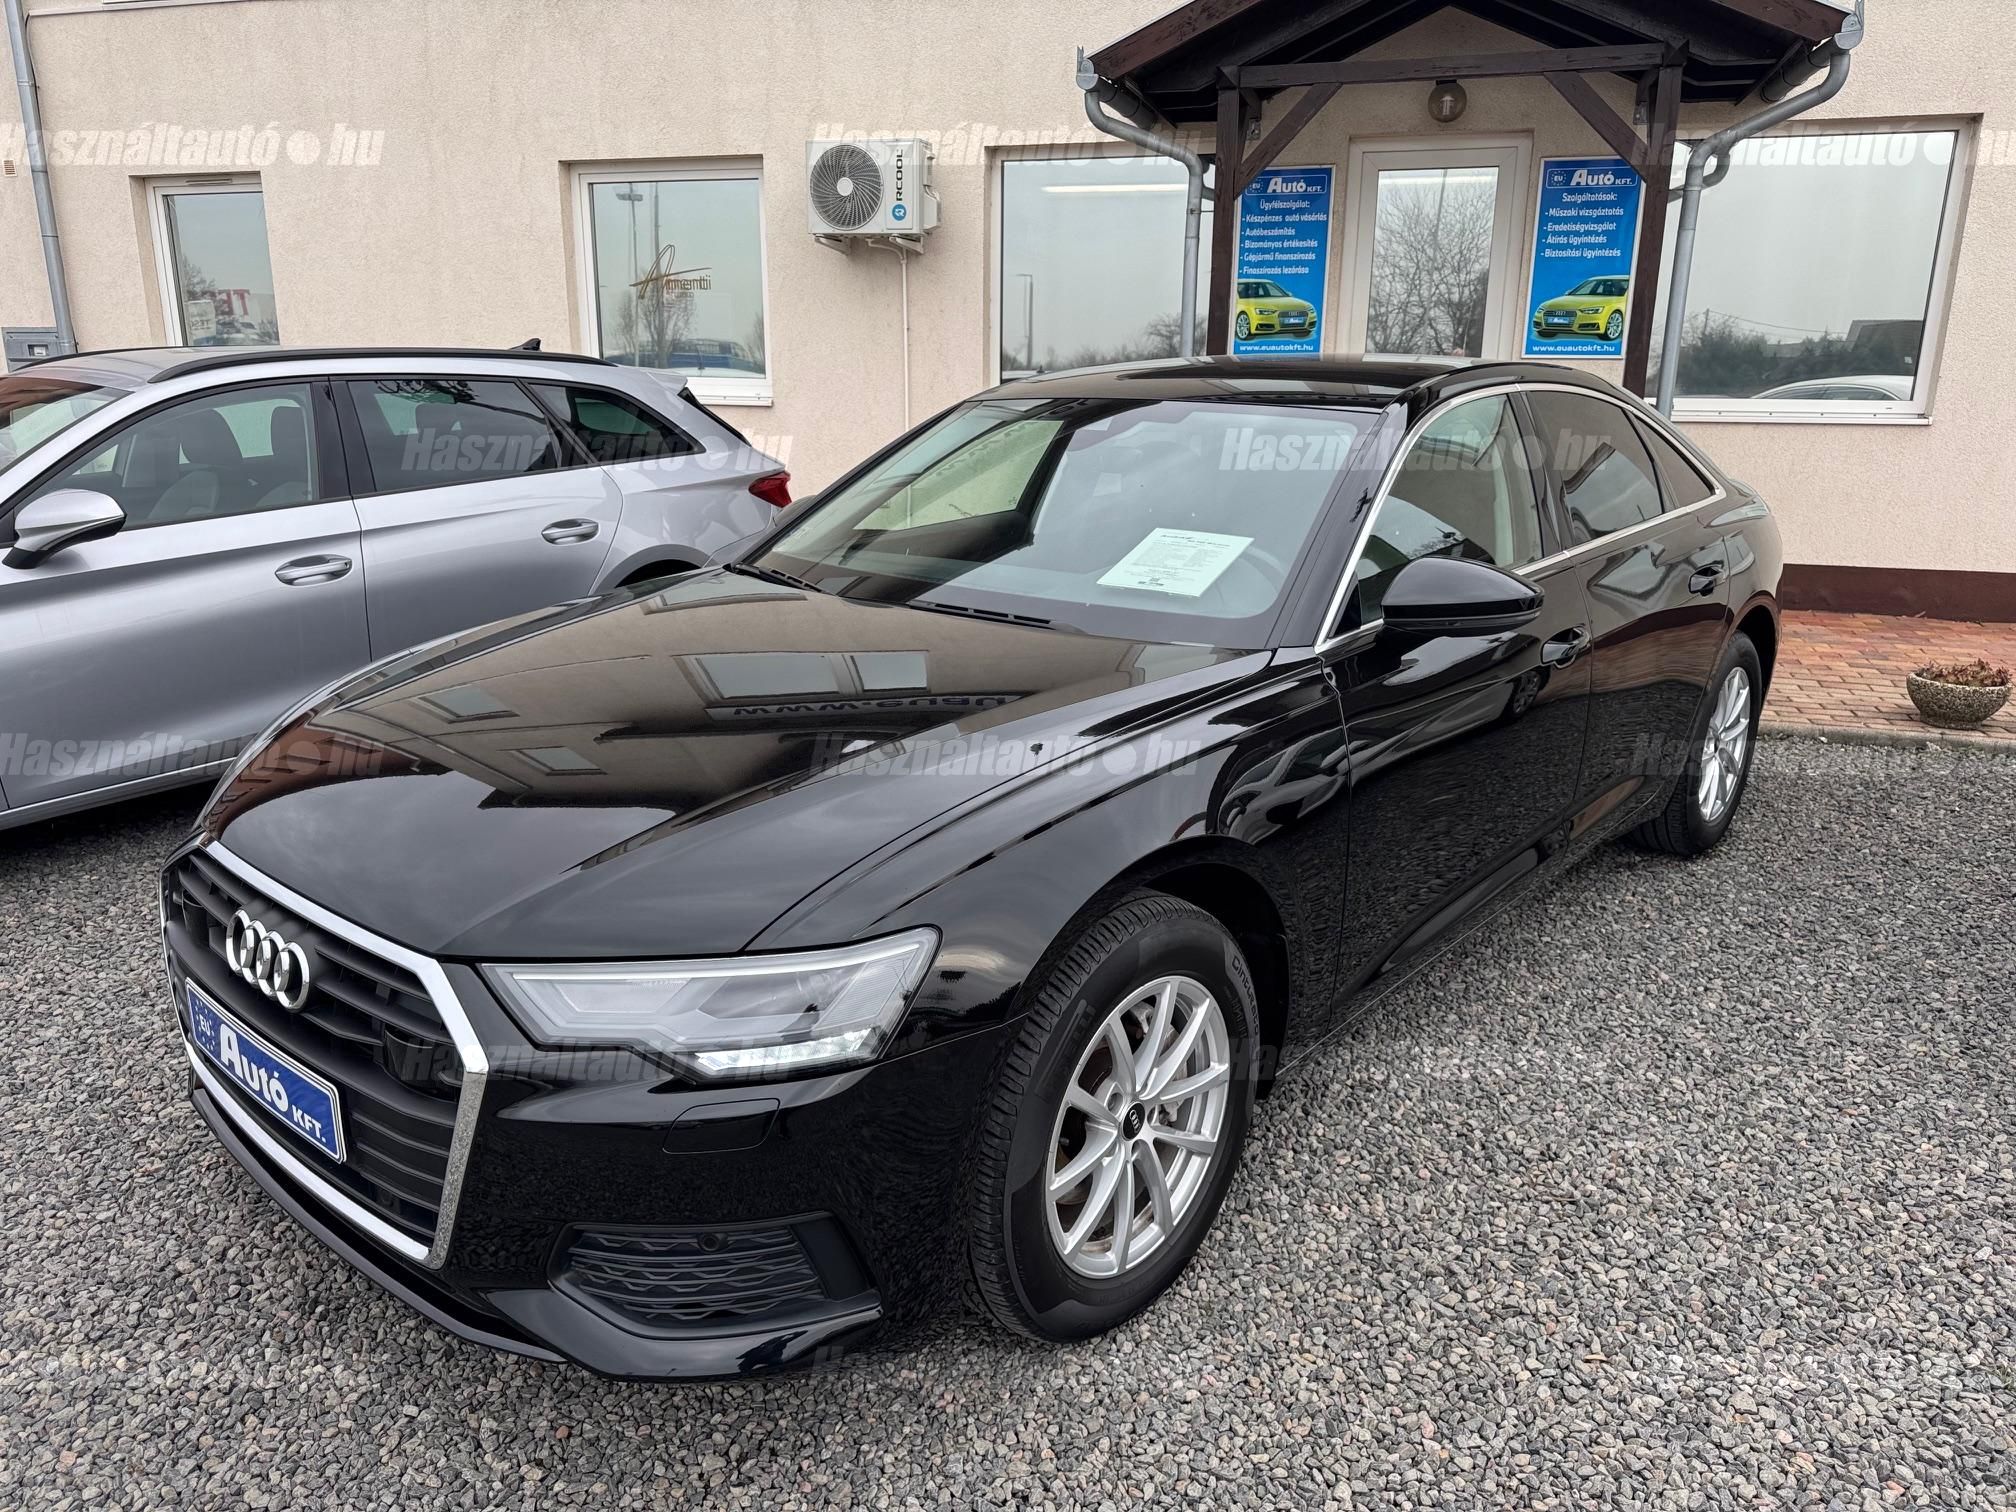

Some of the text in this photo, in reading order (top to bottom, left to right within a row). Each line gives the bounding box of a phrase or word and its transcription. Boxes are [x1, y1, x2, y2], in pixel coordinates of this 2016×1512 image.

[896, 149, 904, 201] RCOOL
[1570, 169, 1615, 186] Autó
[1267, 177, 1306, 193] Autó
[1260, 199, 1310, 210] Ügyfélszolgálat:
[1562, 191, 1618, 203] Szolgáltatások:
[1532, 344, 1615, 352] www.euautokft.hu
[199, 1015, 328, 1143] EU Autó KFT.
